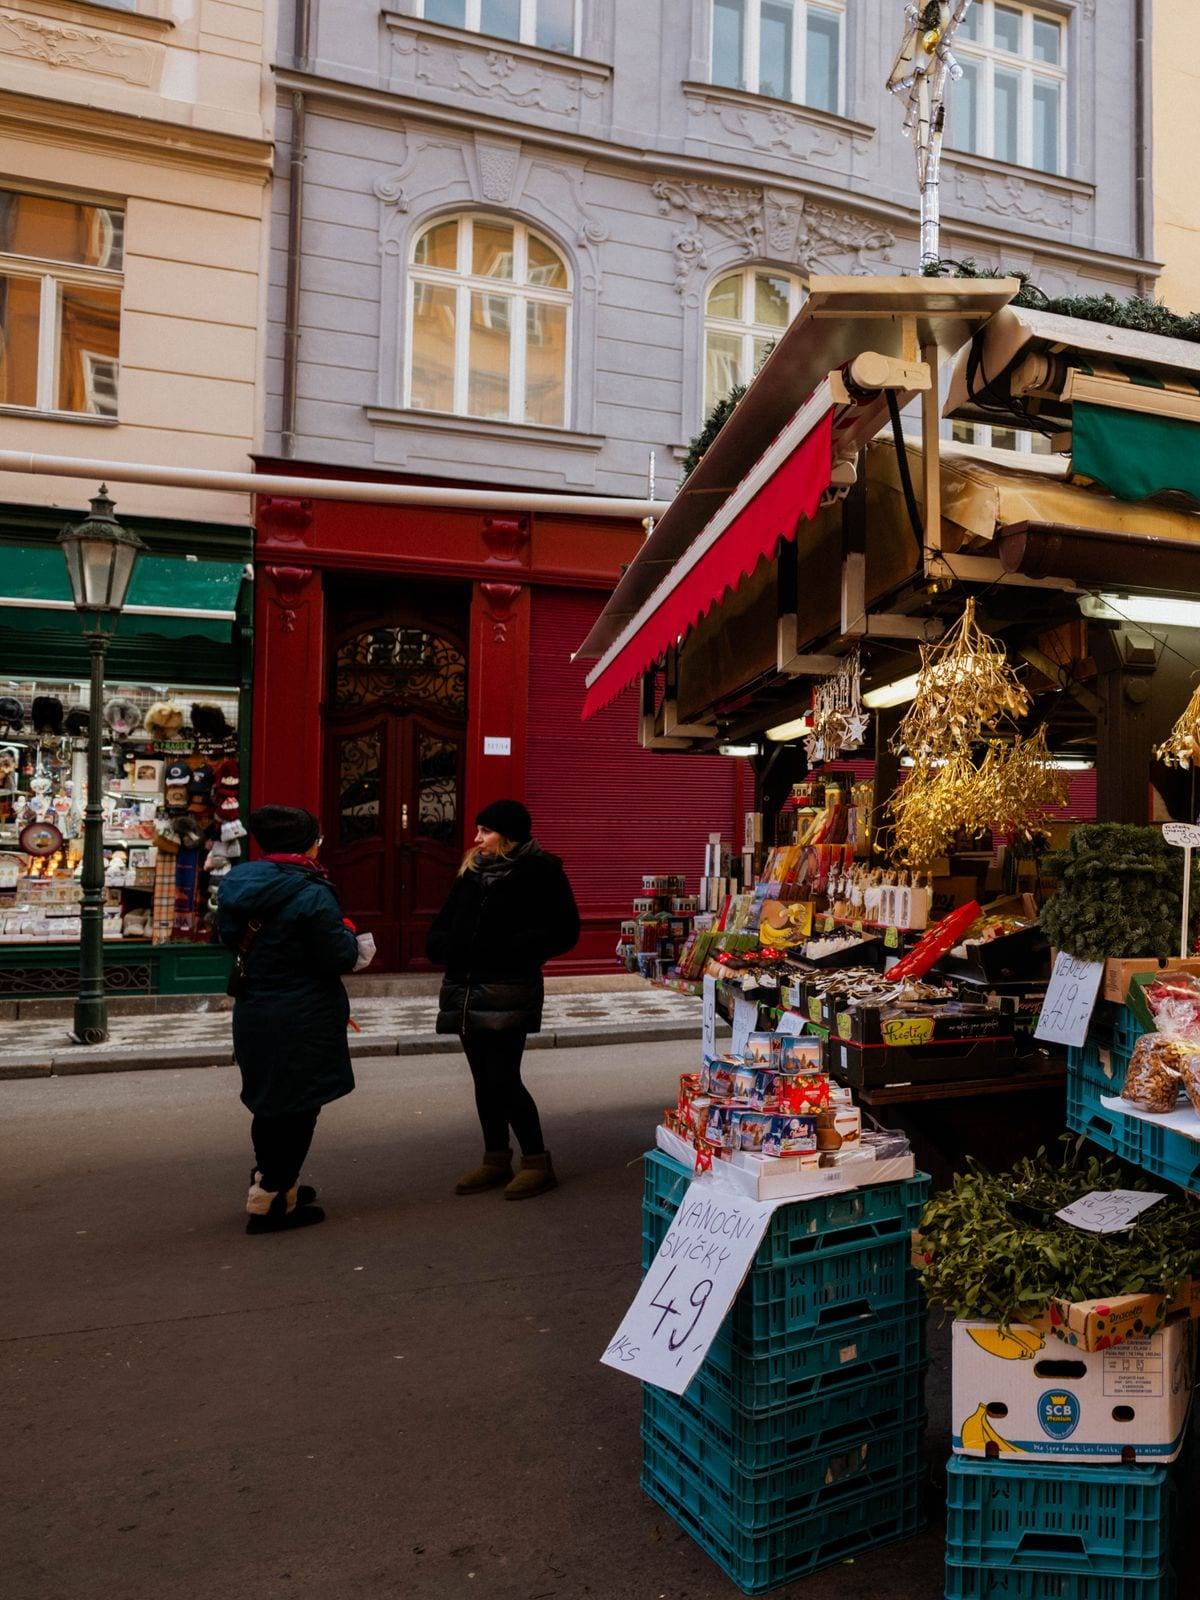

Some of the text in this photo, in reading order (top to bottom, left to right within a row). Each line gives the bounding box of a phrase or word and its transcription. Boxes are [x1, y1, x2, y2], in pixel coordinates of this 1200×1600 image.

[881, 1019, 929, 1045] Prestige
[659, 1232, 731, 1275] SVÍČKY
[1045, 1405, 1072, 1416] SCB
[1046, 1415, 1072, 1423] Premium
